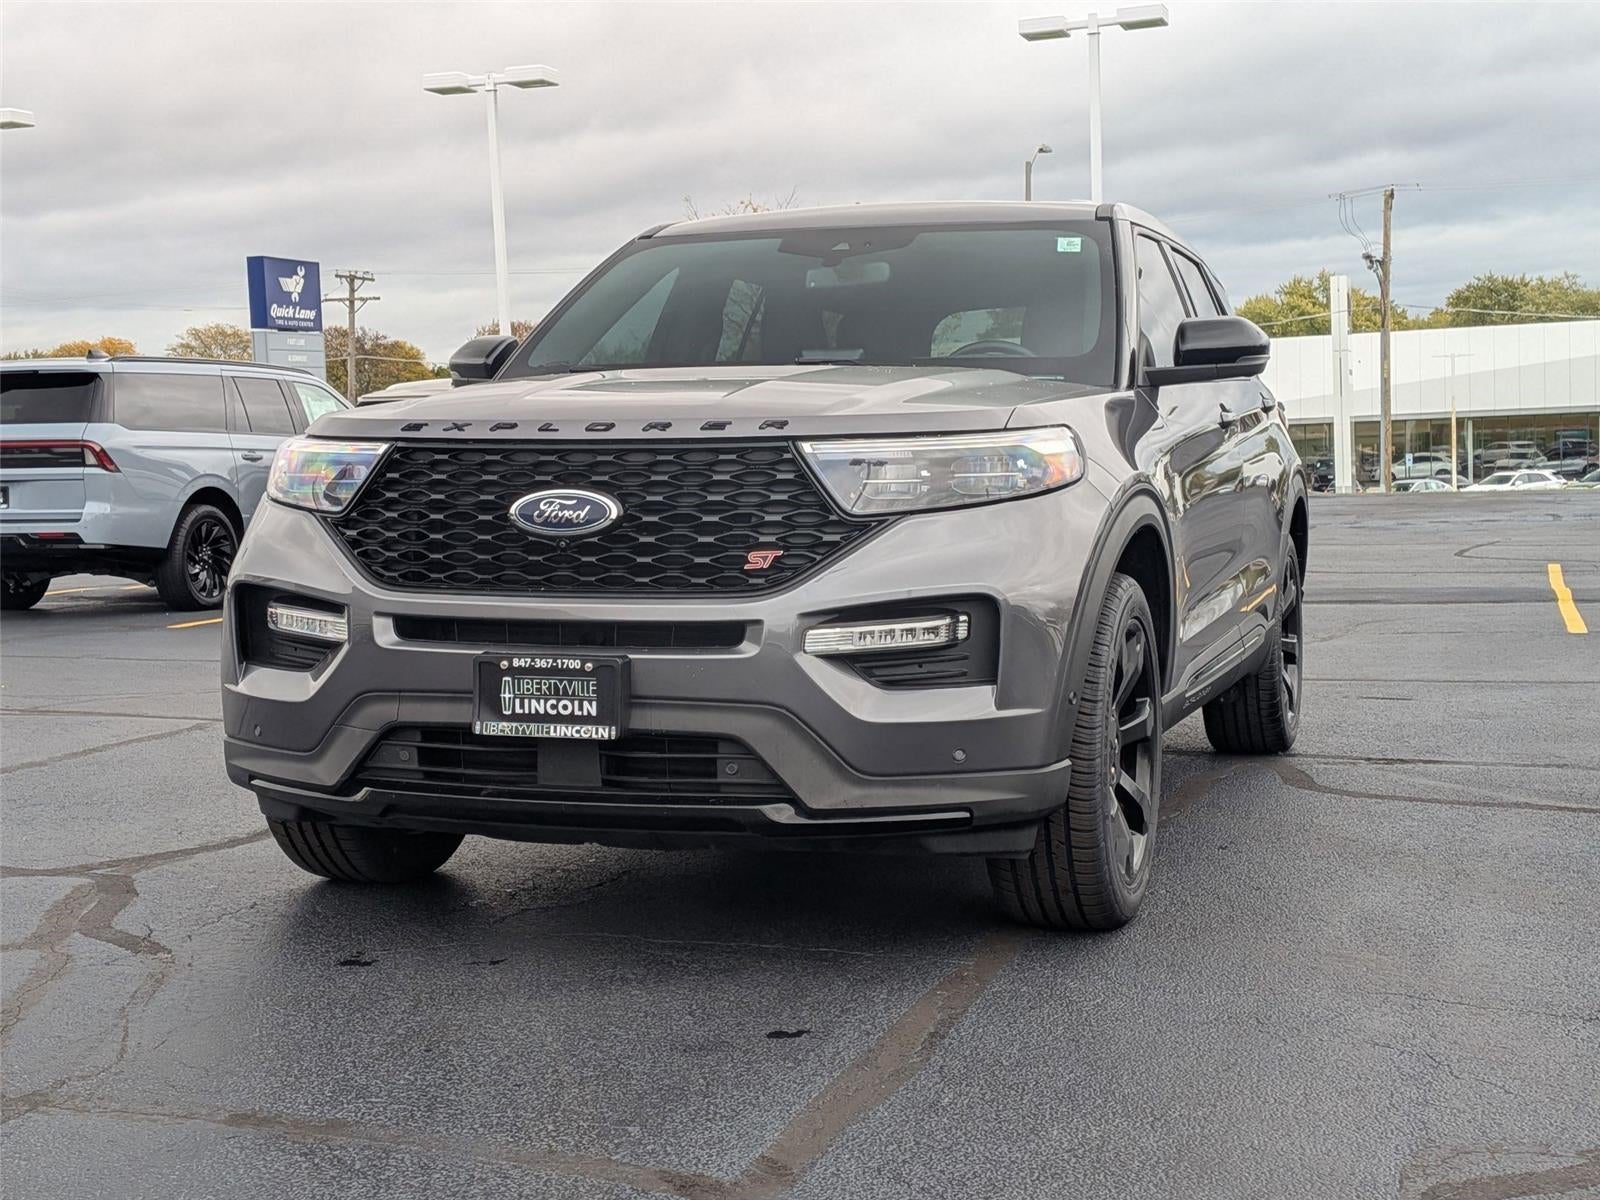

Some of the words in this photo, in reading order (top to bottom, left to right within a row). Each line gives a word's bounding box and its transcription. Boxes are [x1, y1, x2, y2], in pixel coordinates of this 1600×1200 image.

[270, 304, 295, 318] Quick
[295, 306, 316, 320] Lane
[400, 420, 789, 432] EXPLORER
[533, 498, 590, 525] Ford
[744, 550, 784, 570] ST
[512, 657, 581, 670] 847-367-1700
[514, 679, 597, 697] LIBERTYVILLE
[514, 698, 597, 717] LINCOLN
